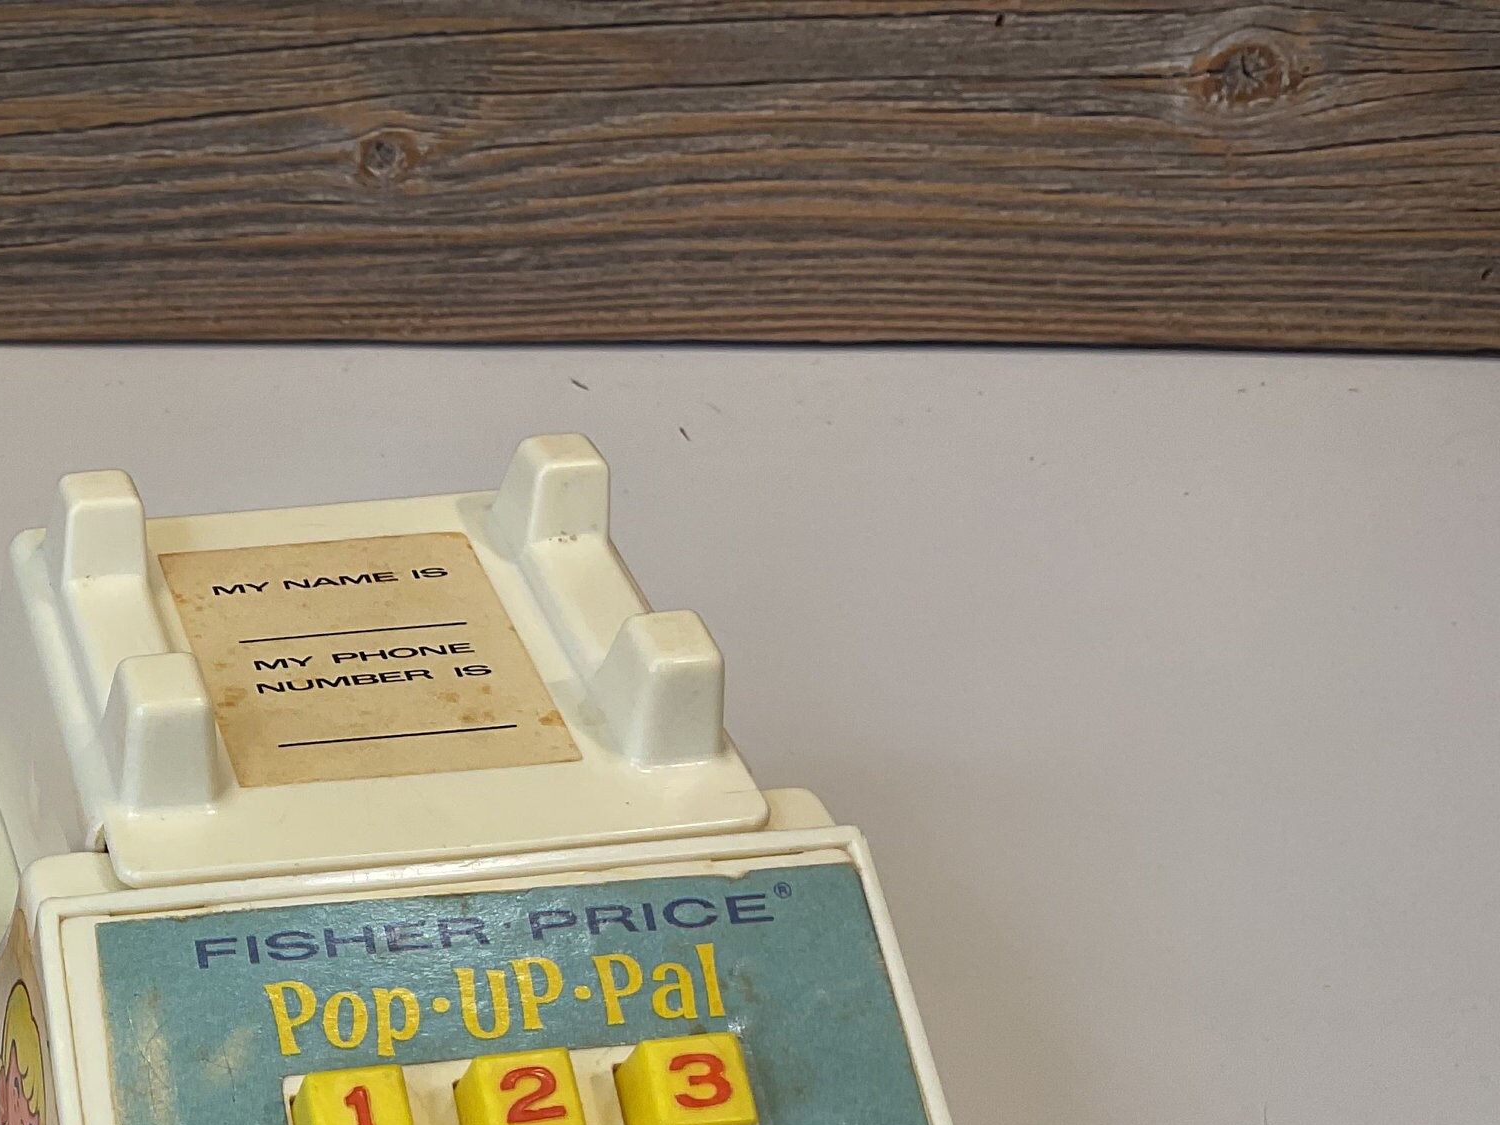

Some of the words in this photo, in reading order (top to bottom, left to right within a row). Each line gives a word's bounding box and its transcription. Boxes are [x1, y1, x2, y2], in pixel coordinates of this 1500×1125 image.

[211, 581, 269, 596] MY
[284, 570, 399, 590] NAME
[412, 566, 449, 580] IS
[253, 655, 313, 671] MY
[331, 642, 475, 664] PHONE
[256, 669, 434, 694] NUMBER
[455, 663, 493, 678] IS
[194, 916, 490, 969] FISHER
[500, 1066, 567, 1125] 2
[669, 1053, 733, 1108] 3
